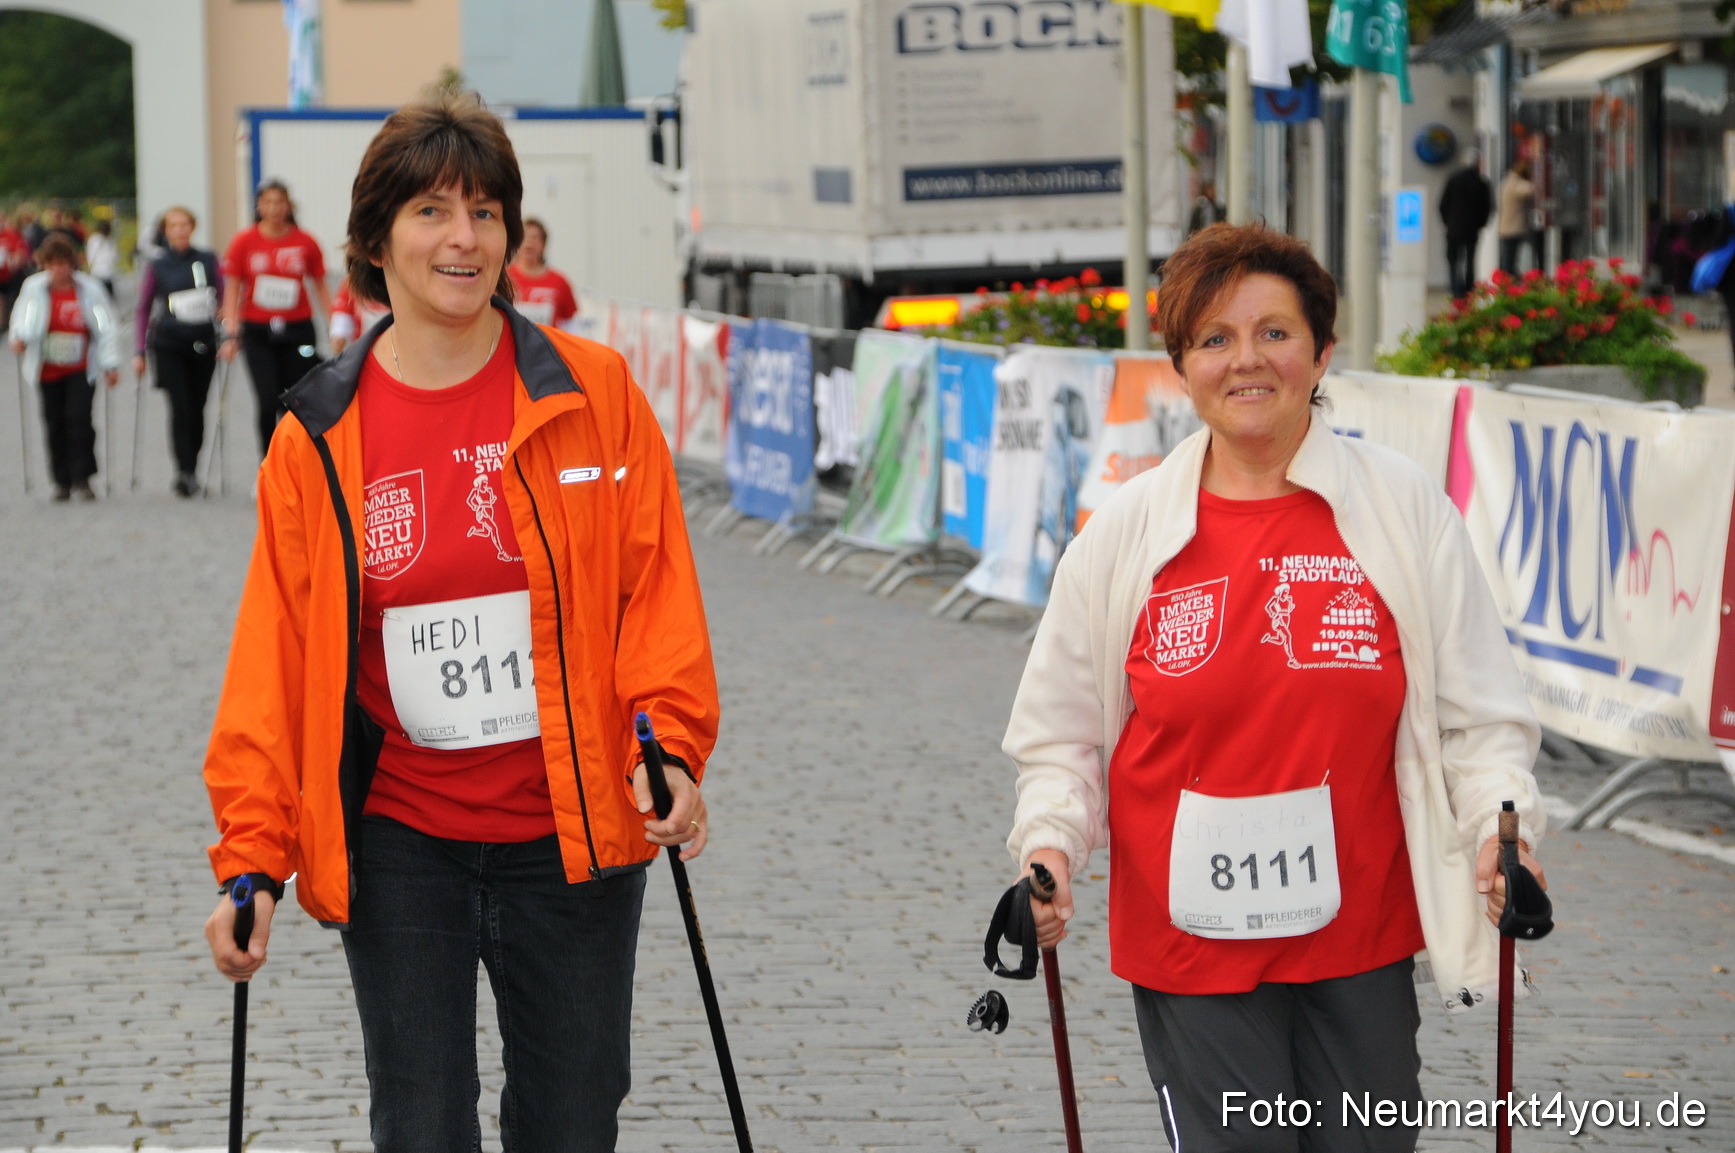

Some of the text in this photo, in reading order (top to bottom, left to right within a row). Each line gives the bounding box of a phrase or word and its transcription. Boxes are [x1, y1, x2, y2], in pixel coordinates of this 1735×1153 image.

[896, 0, 1121, 53] BOCK
[453, 441, 510, 463] 11. NEU
[474, 457, 504, 474] STA
[364, 487, 412, 514] MMER
[364, 542, 414, 567] MARKT
[1259, 556, 1280, 571] 11.
[1279, 568, 1366, 586] STADTLAUF
[1184, 588, 1203, 600] Jahre
[1160, 593, 1214, 621] IMMER
[1157, 606, 1214, 634] WIEDER
[411, 614, 481, 656] HEDI
[1155, 621, 1210, 651] NEU
[1319, 628, 1379, 644] 19.09.2010
[1156, 642, 1207, 665] MARKT
[1178, 807, 1312, 841] Christa
[1210, 845, 1317, 891] 8111
[1264, 907, 1323, 924] PFLEIDERER
